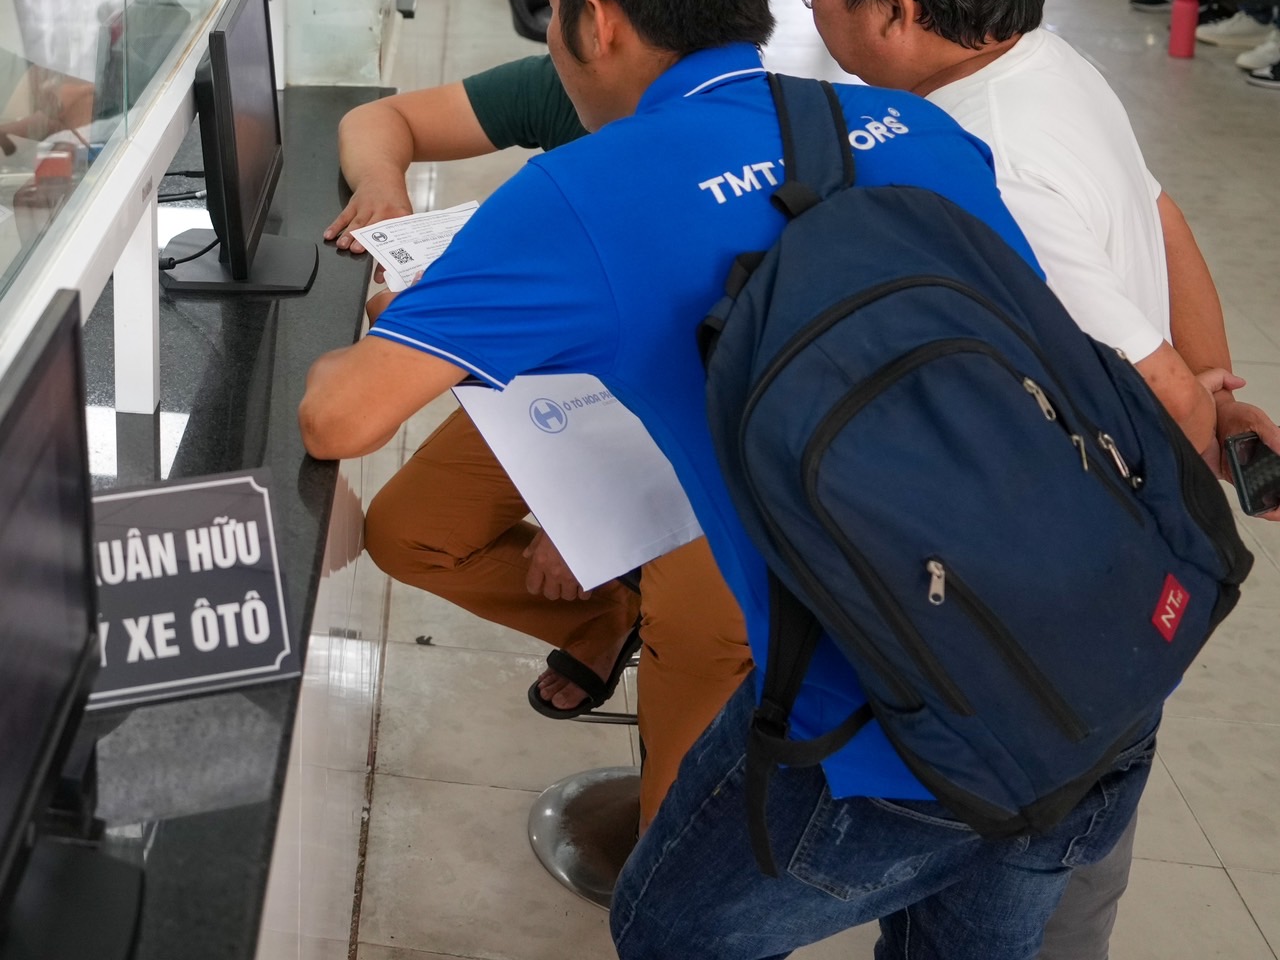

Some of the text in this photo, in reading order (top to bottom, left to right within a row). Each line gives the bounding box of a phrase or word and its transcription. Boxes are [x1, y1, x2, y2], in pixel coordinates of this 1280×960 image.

[698, 161, 778, 204] TMT
[95, 516, 261, 586] UÂN HỮU
[122, 612, 180, 664] XE
[191, 590, 271, 652] ÔTÔ
